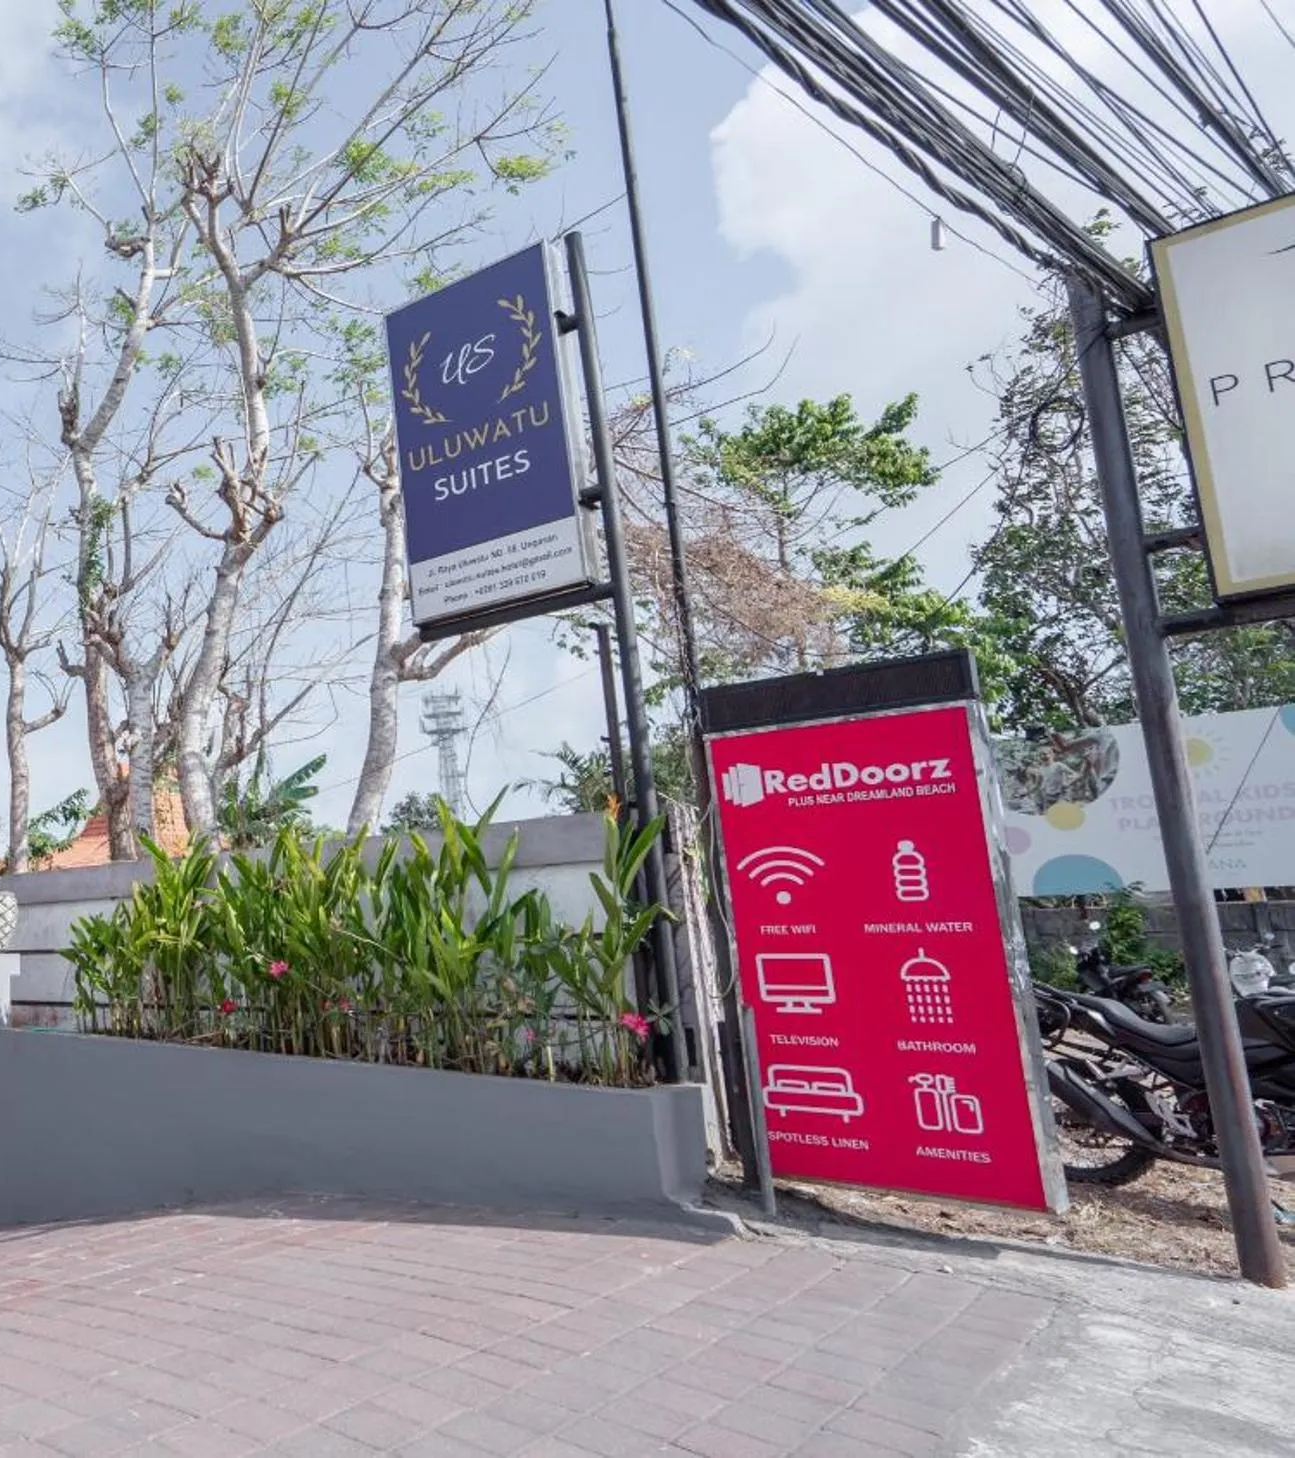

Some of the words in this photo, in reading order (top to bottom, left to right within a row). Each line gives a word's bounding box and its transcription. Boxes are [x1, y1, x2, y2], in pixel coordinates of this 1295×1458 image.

[408, 401, 549, 471] ULUWATU
[434, 449, 531, 501] SUITES
[765, 758, 952, 795] RedDoorz
[788, 795, 814, 807] PLUS
[816, 792, 845, 805] NEAR
[847, 786, 914, 802] DREAMLAND
[916, 782, 956, 796] BEACH
[760, 924, 789, 935] FREE
[791, 924, 817, 935] WIFI
[864, 922, 922, 934] MINERAL
[926, 921, 973, 933] WATER
[769, 1034, 839, 1048] TELEVISION
[897, 1040, 976, 1055] BATHROOM
[767, 1131, 829, 1147] SPOTLESS
[832, 1136, 869, 1150] LINEN
[916, 1146, 991, 1164] AMENITIES
